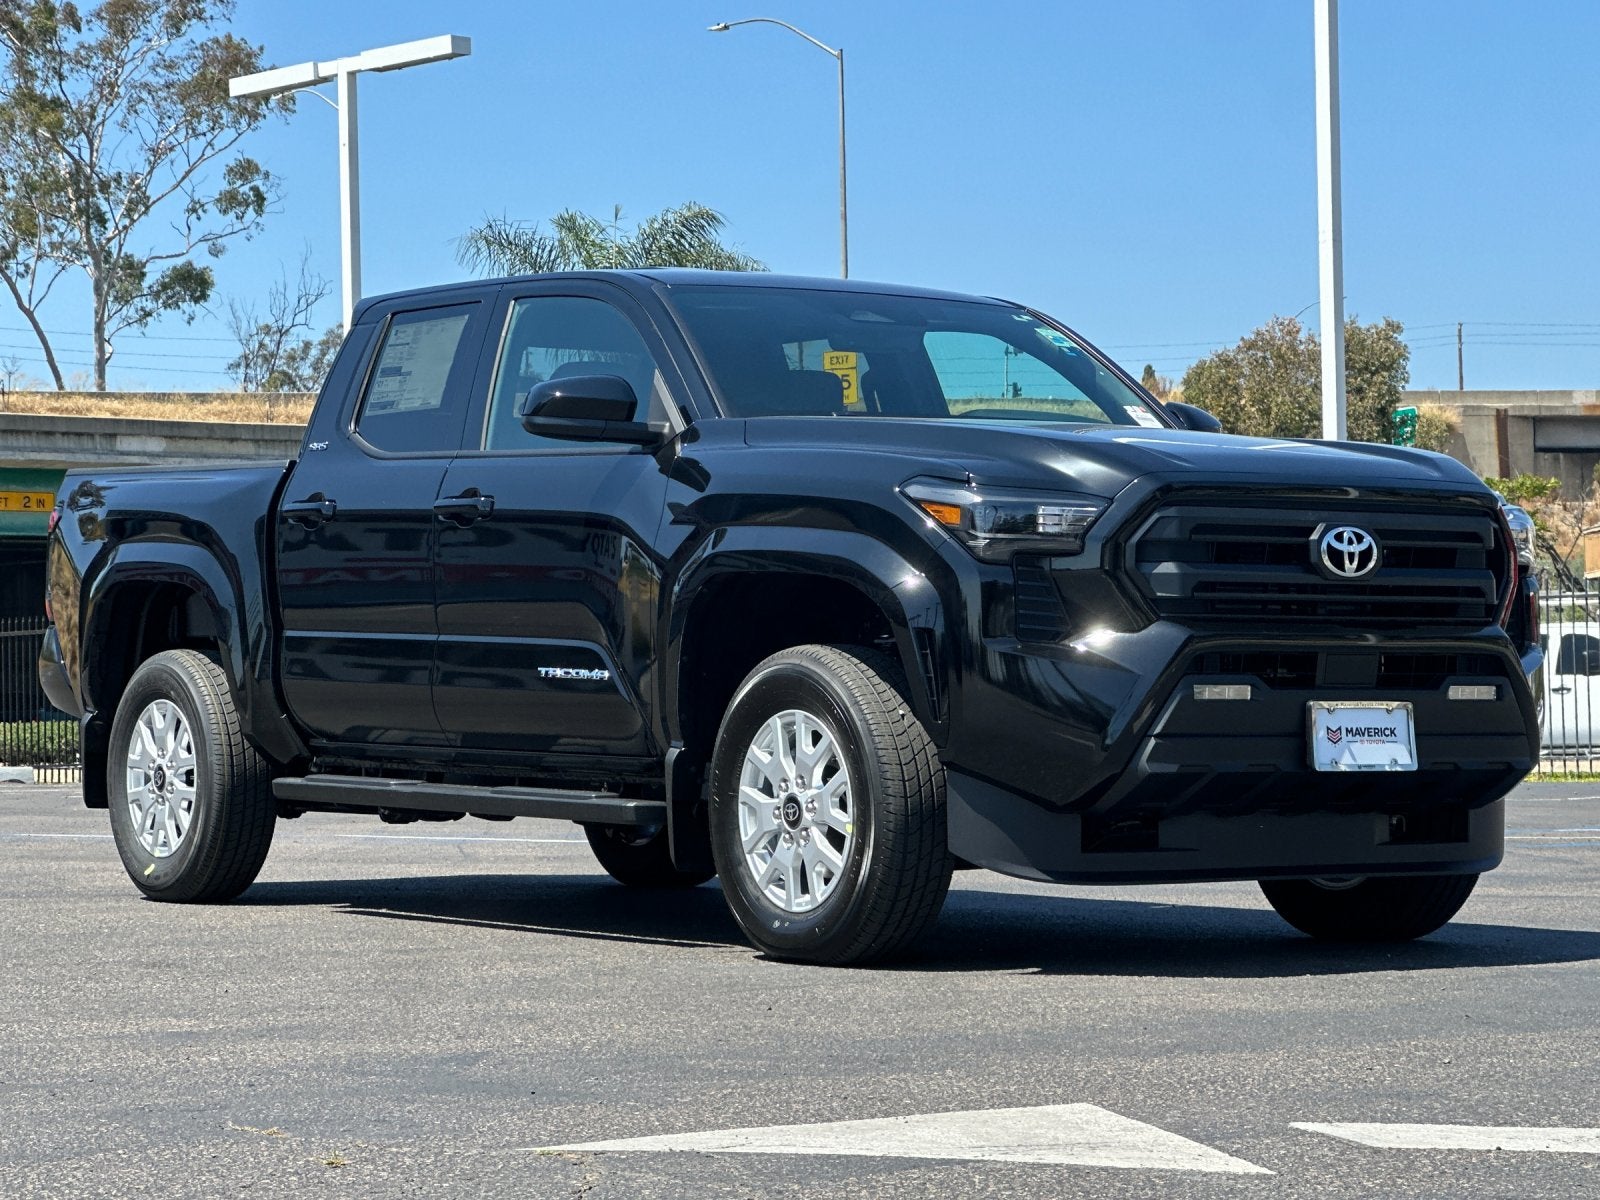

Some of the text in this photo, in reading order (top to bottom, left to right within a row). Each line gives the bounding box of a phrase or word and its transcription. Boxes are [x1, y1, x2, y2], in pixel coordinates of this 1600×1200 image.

[830, 355, 849, 365] EXIT
[841, 374, 851, 390] 5
[23, 496, 31, 508] 2
[36, 498, 45, 508] IN
[538, 667, 609, 680] TACOMA
[1345, 727, 1397, 738] MAVERICK
